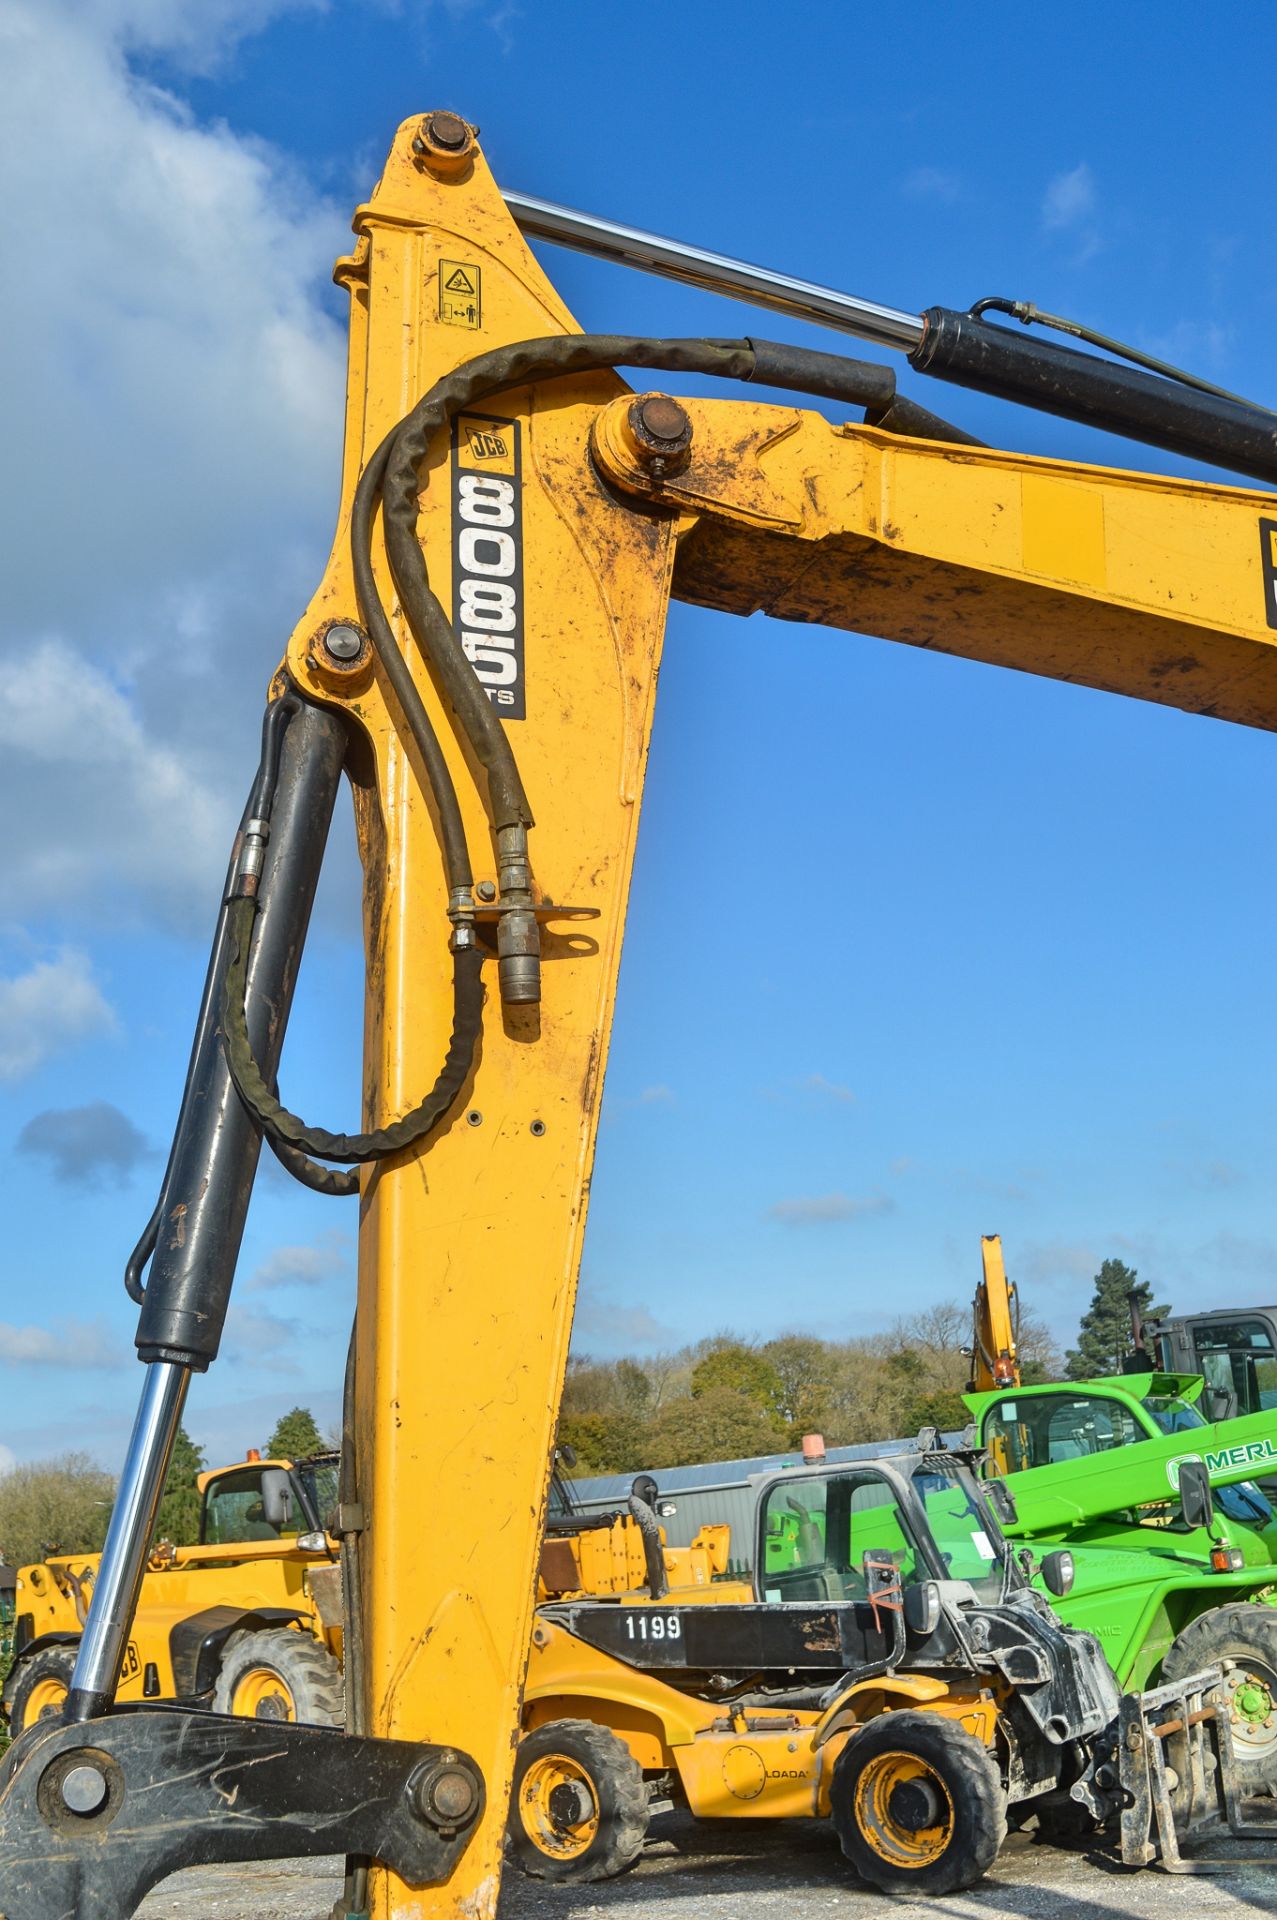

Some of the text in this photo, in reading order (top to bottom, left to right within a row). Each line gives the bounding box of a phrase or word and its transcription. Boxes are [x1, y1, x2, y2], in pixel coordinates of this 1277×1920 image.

[472, 431, 506, 457] JCB
[458, 474, 517, 685] 8085
[483, 687, 515, 705] TS
[626, 1616, 681, 1639] 1199
[765, 1770, 809, 1778] LOADA
